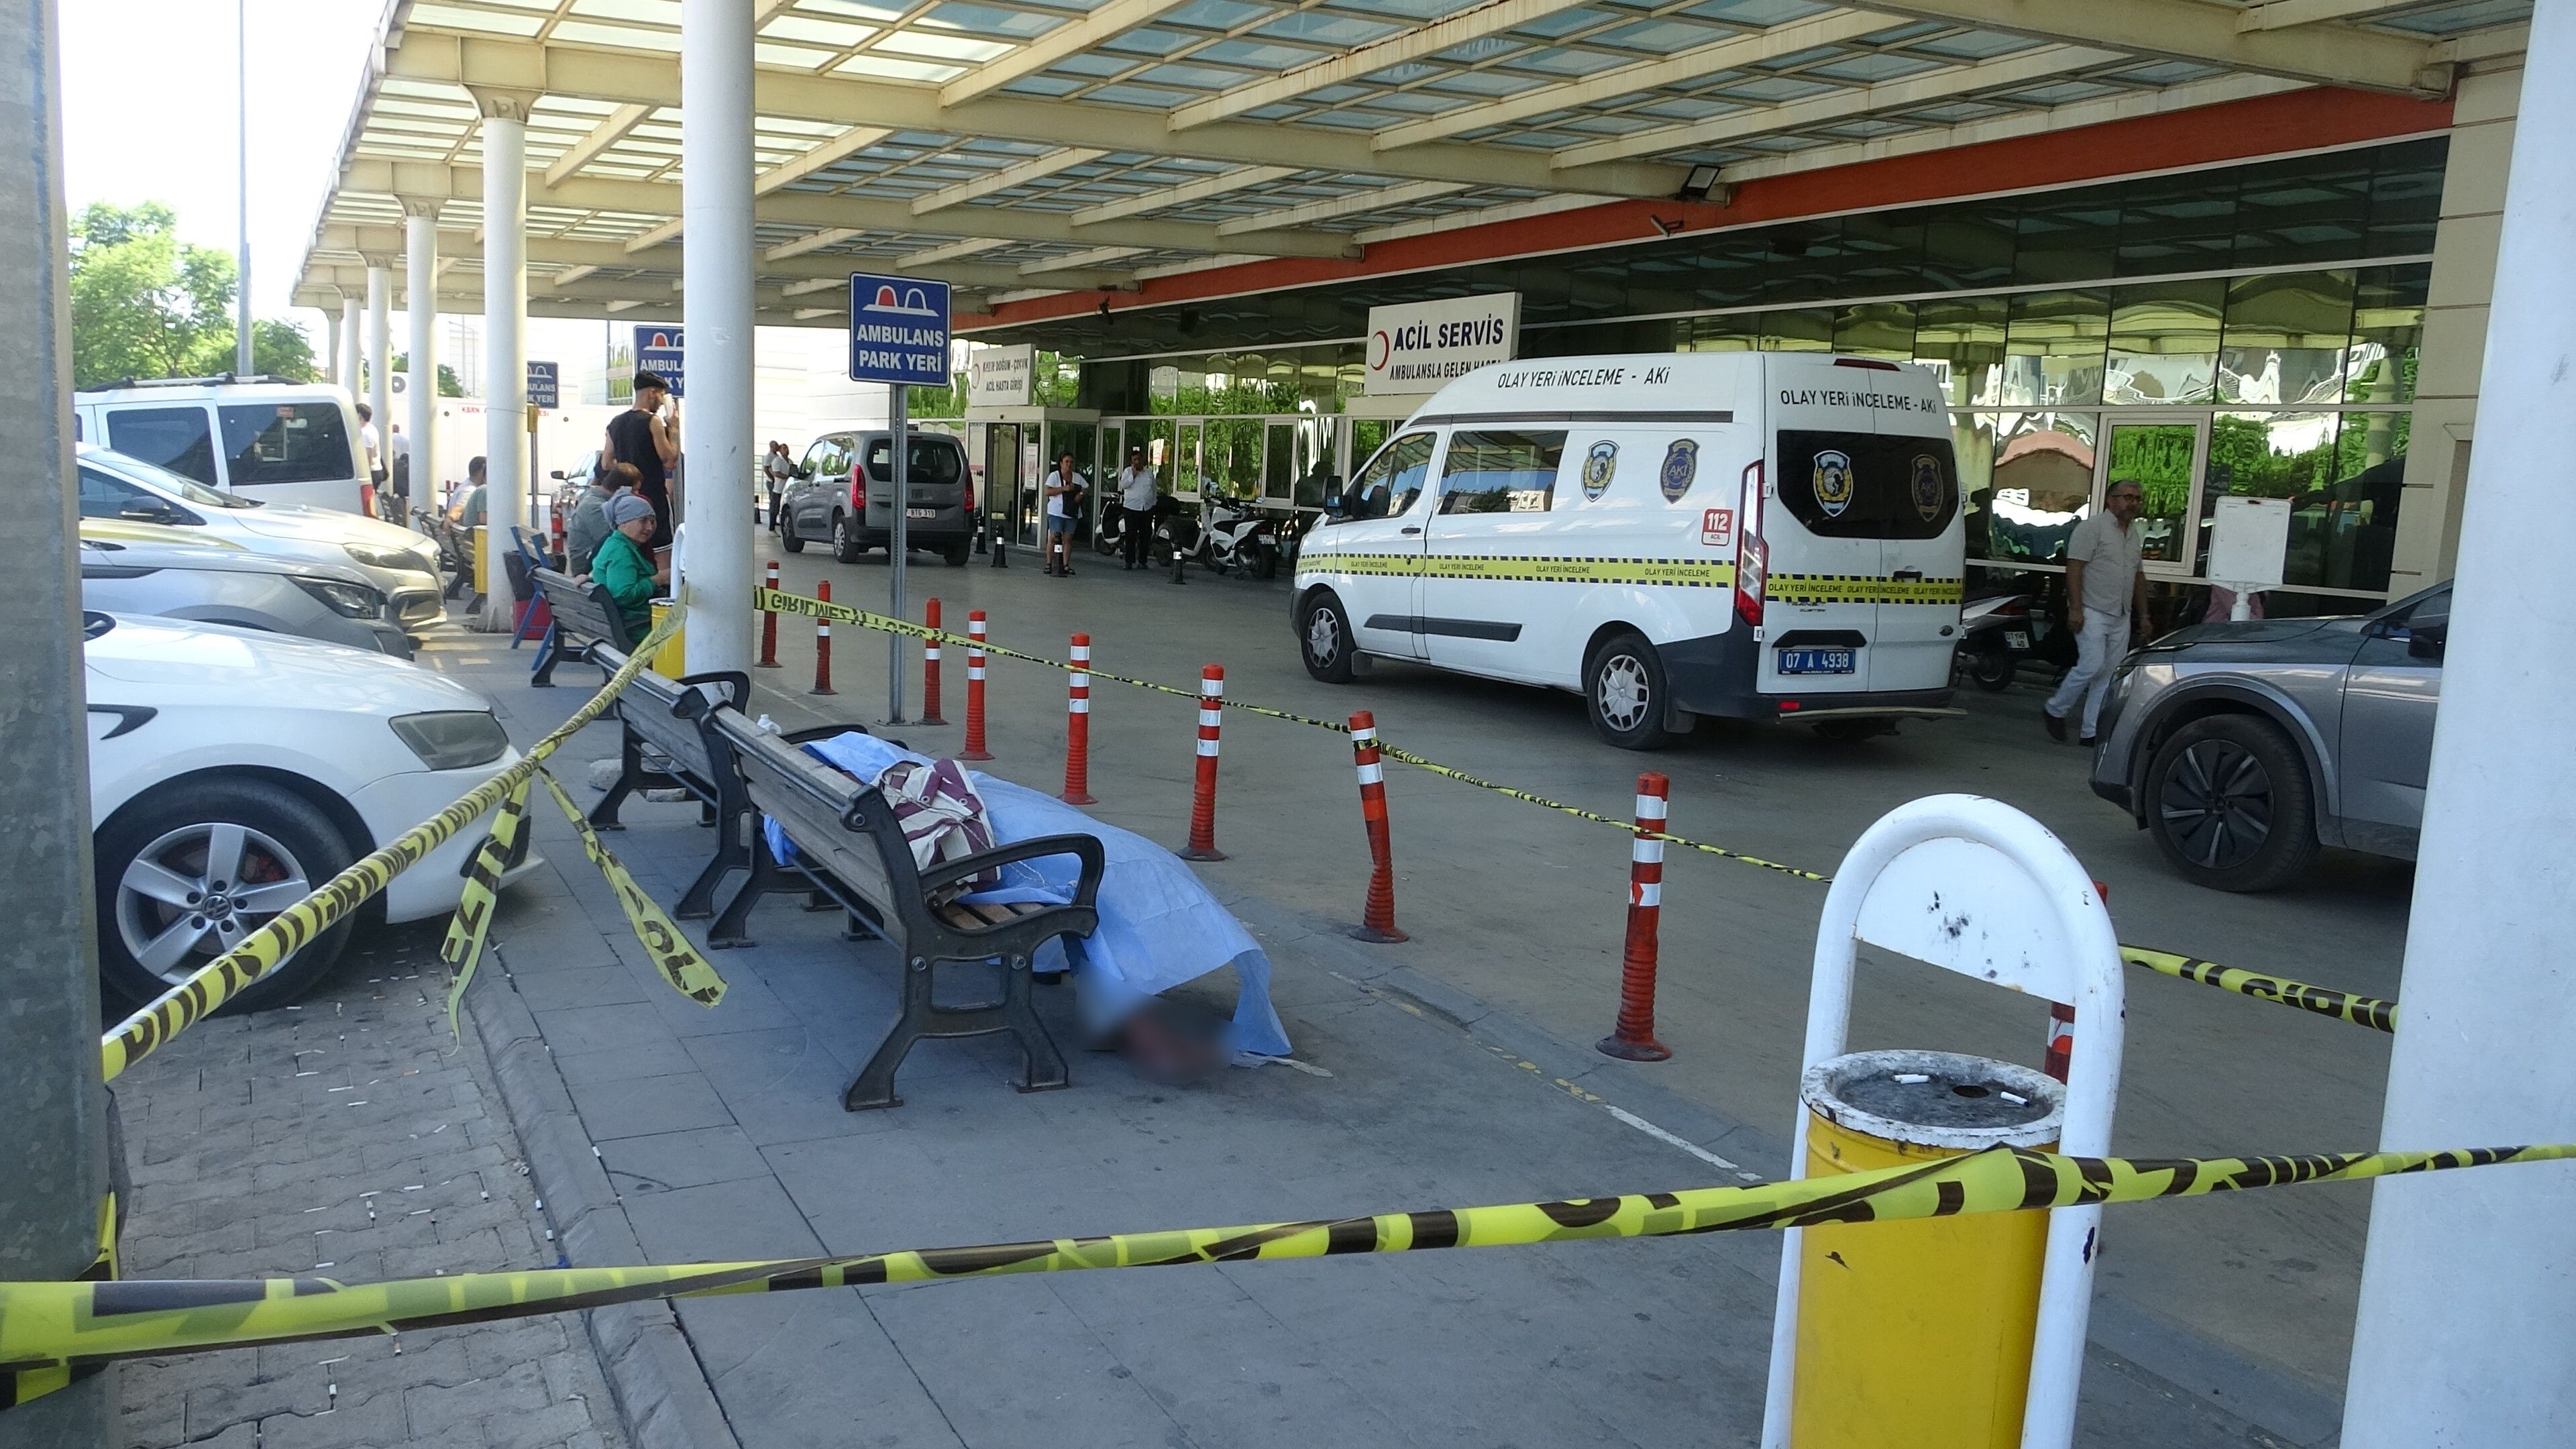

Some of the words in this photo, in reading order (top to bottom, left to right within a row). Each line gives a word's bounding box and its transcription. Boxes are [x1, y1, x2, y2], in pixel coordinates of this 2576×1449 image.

[857, 324, 944, 347] AMBULANS
[1393, 319, 1432, 351] ACİL
[1438, 313, 1504, 348] SERVİS
[859, 350, 902, 370] PARK
[906, 352, 942, 372] YERİ
[1389, 362, 1442, 380] AMBULANSLA
[1497, 372, 1529, 388] OLAY
[1780, 389, 1817, 405] OLAY
[1707, 513, 1729, 531] 112
[1550, 564, 1562, 574] YERİ
[1562, 564, 1591, 574] İNCELEME
[1644, 568, 1662, 576] OLAY
[1662, 567, 1676, 576] YERİ
[1676, 567, 1711, 577] İNCELEME
[1768, 583, 1789, 591] OLAY
[1791, 582, 1807, 592] YERİ
[1808, 582, 1843, 592] İNCELEME
[1847, 585, 1864, 593] OLAY
[1786, 653, 1801, 668] 07
[1807, 653, 1814, 668] A
[1821, 653, 1849, 668] 4938
